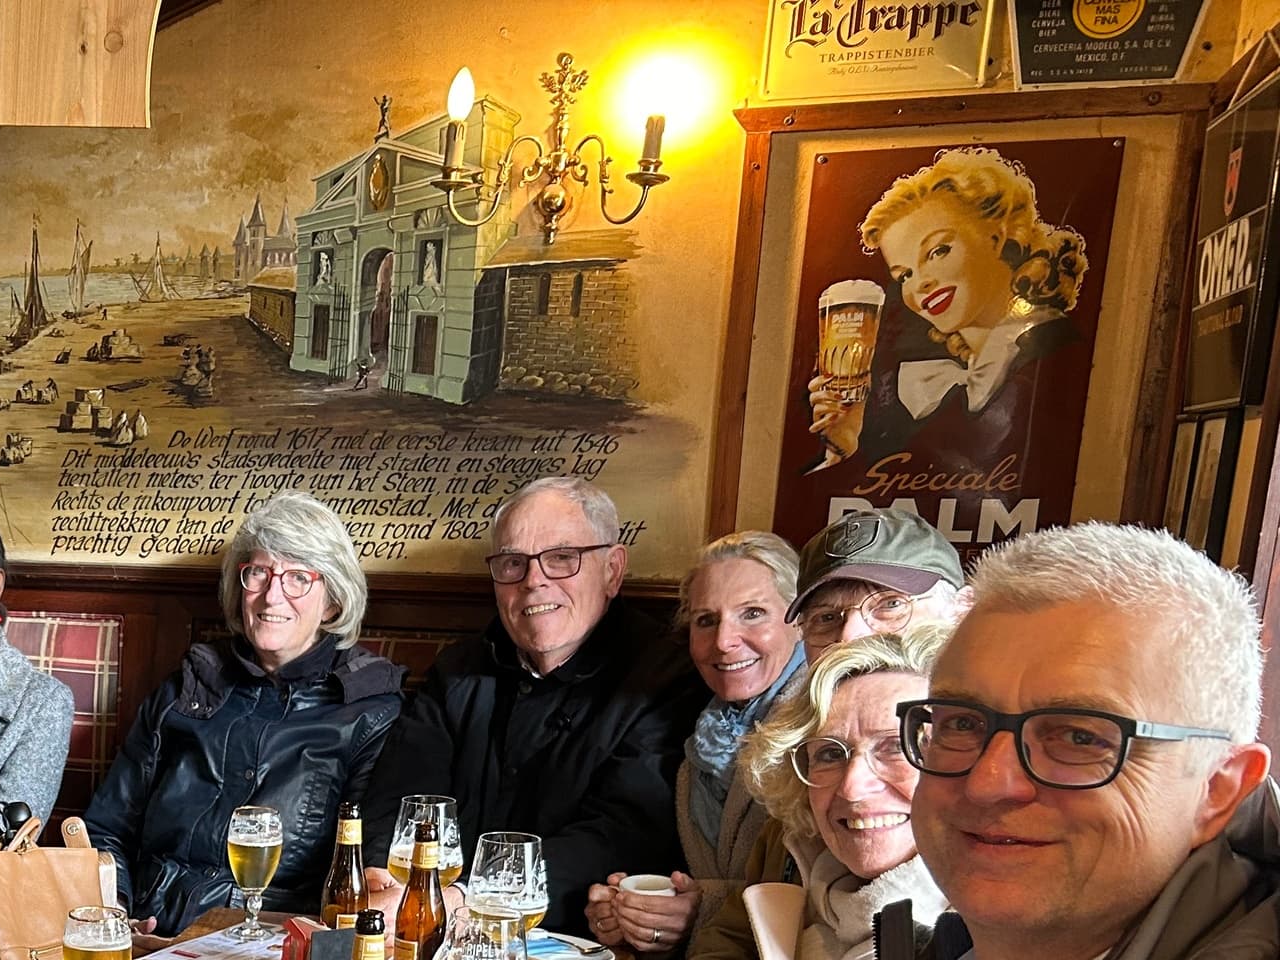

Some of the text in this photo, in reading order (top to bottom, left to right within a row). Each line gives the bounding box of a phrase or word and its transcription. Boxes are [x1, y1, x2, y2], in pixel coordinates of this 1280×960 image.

[1094, 15, 1119, 25] FINA
[1095, 4, 1120, 14] MAS
[820, 46, 935, 63] TRAPPISTENBIER
[1033, 42, 1082, 53] CERVECERIA
[1143, 39, 1155, 48] DE
[239, 428, 282, 449] rond
[286, 427, 334, 450] 1617
[331, 429, 368, 450] met
[374, 430, 394, 449] de
[397, 431, 458, 451] eerste
[462, 431, 524, 452] kraan
[531, 430, 567, 452] uit
[571, 432, 621, 455] 1546
[60, 449, 92, 468] Dit
[94, 448, 202, 469] middeleeuws
[207, 449, 335, 472] stadsgedeelte
[340, 451, 377, 471] met
[377, 451, 452, 473] straten
[456, 457, 483, 473] en
[571, 454, 608, 482] lag
[58, 468, 141, 488] tientallen
[208, 471, 238, 490] ter
[240, 469, 305, 494] hoogte
[348, 471, 379, 492] het
[445, 472, 467, 494] in
[471, 473, 499, 494] de
[51, 489, 104, 511] Rechts
[106, 491, 131, 511] de
[440, 498, 481, 519] Met
[51, 511, 171, 536] rechttrekking
[210, 516, 234, 535] de
[381, 519, 436, 540] rond
[441, 520, 490, 540] 1802
[51, 533, 133, 557] prachtig
[139, 534, 225, 559] gedeelte
